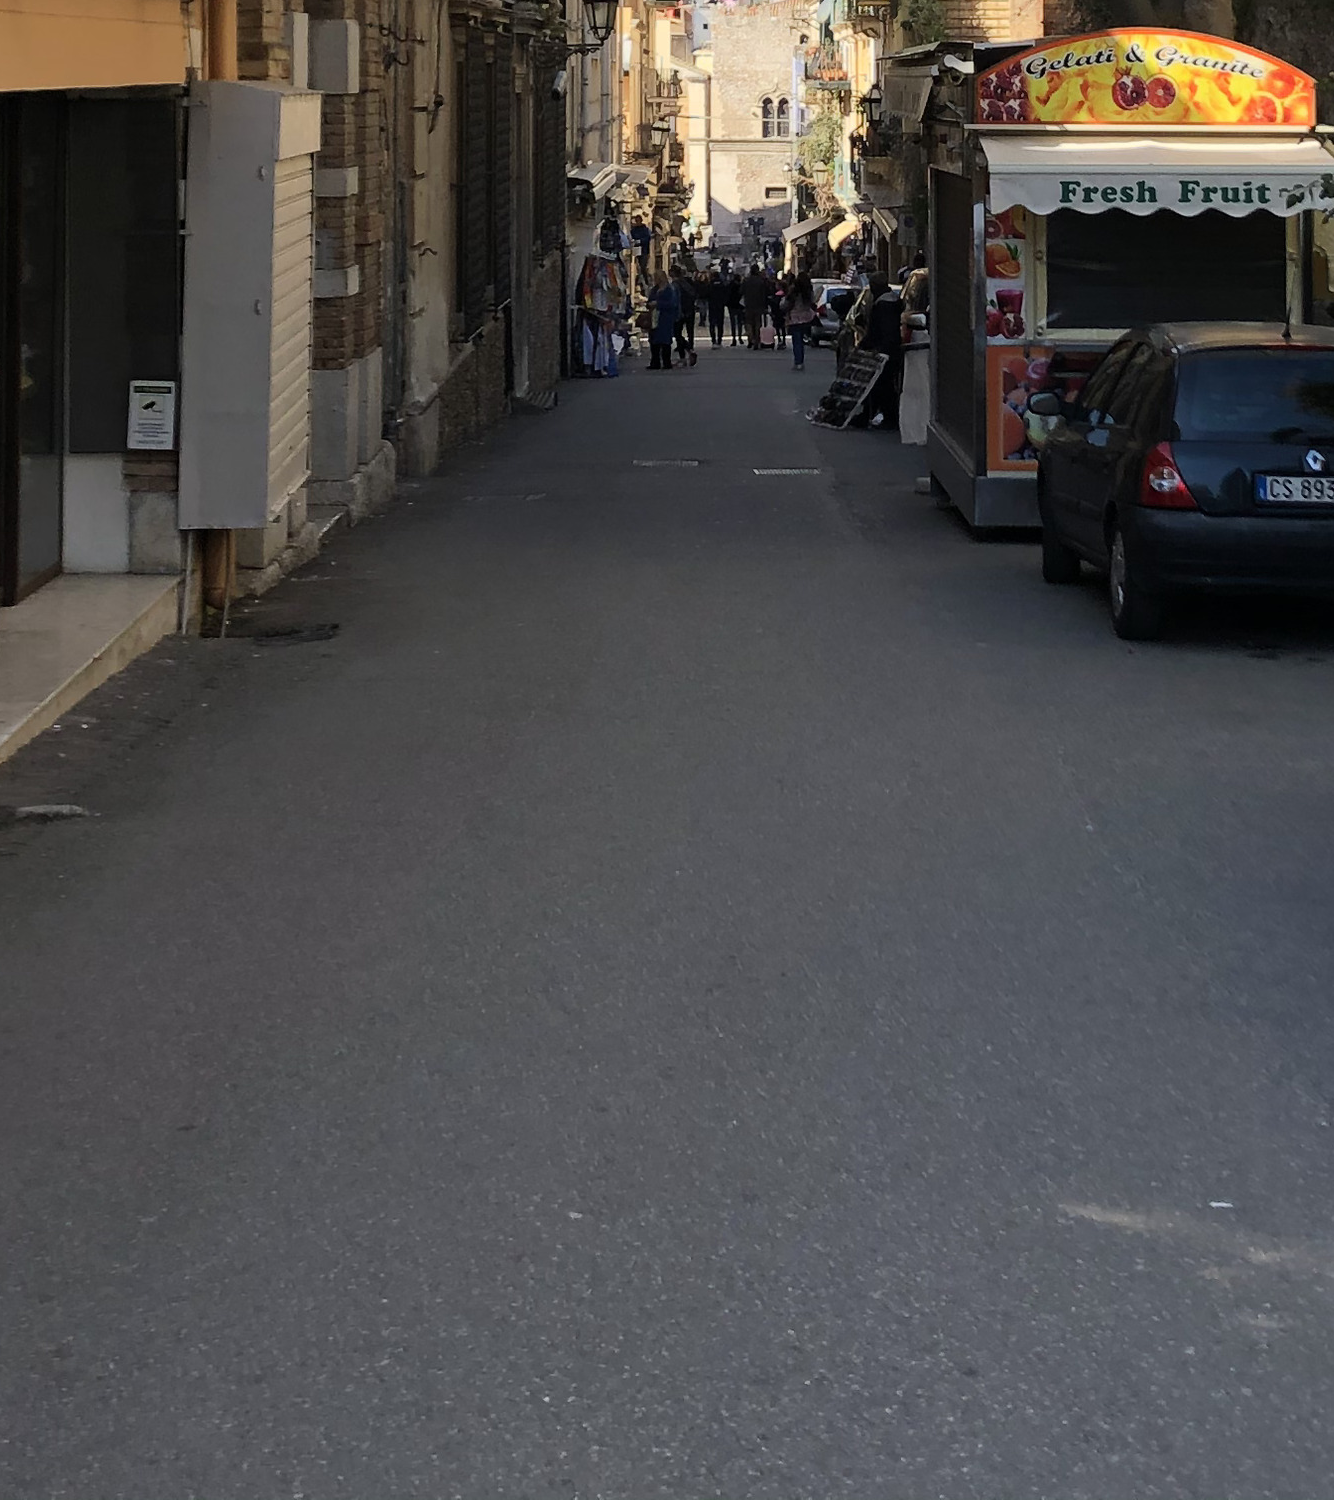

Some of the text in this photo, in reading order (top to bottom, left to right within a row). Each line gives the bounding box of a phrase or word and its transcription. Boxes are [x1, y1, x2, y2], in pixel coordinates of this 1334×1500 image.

[1025, 44, 1264, 79] Gelati & Granite
[1058, 179, 1271, 204] Fresh Fruit
[1268, 477, 1294, 499] CS
